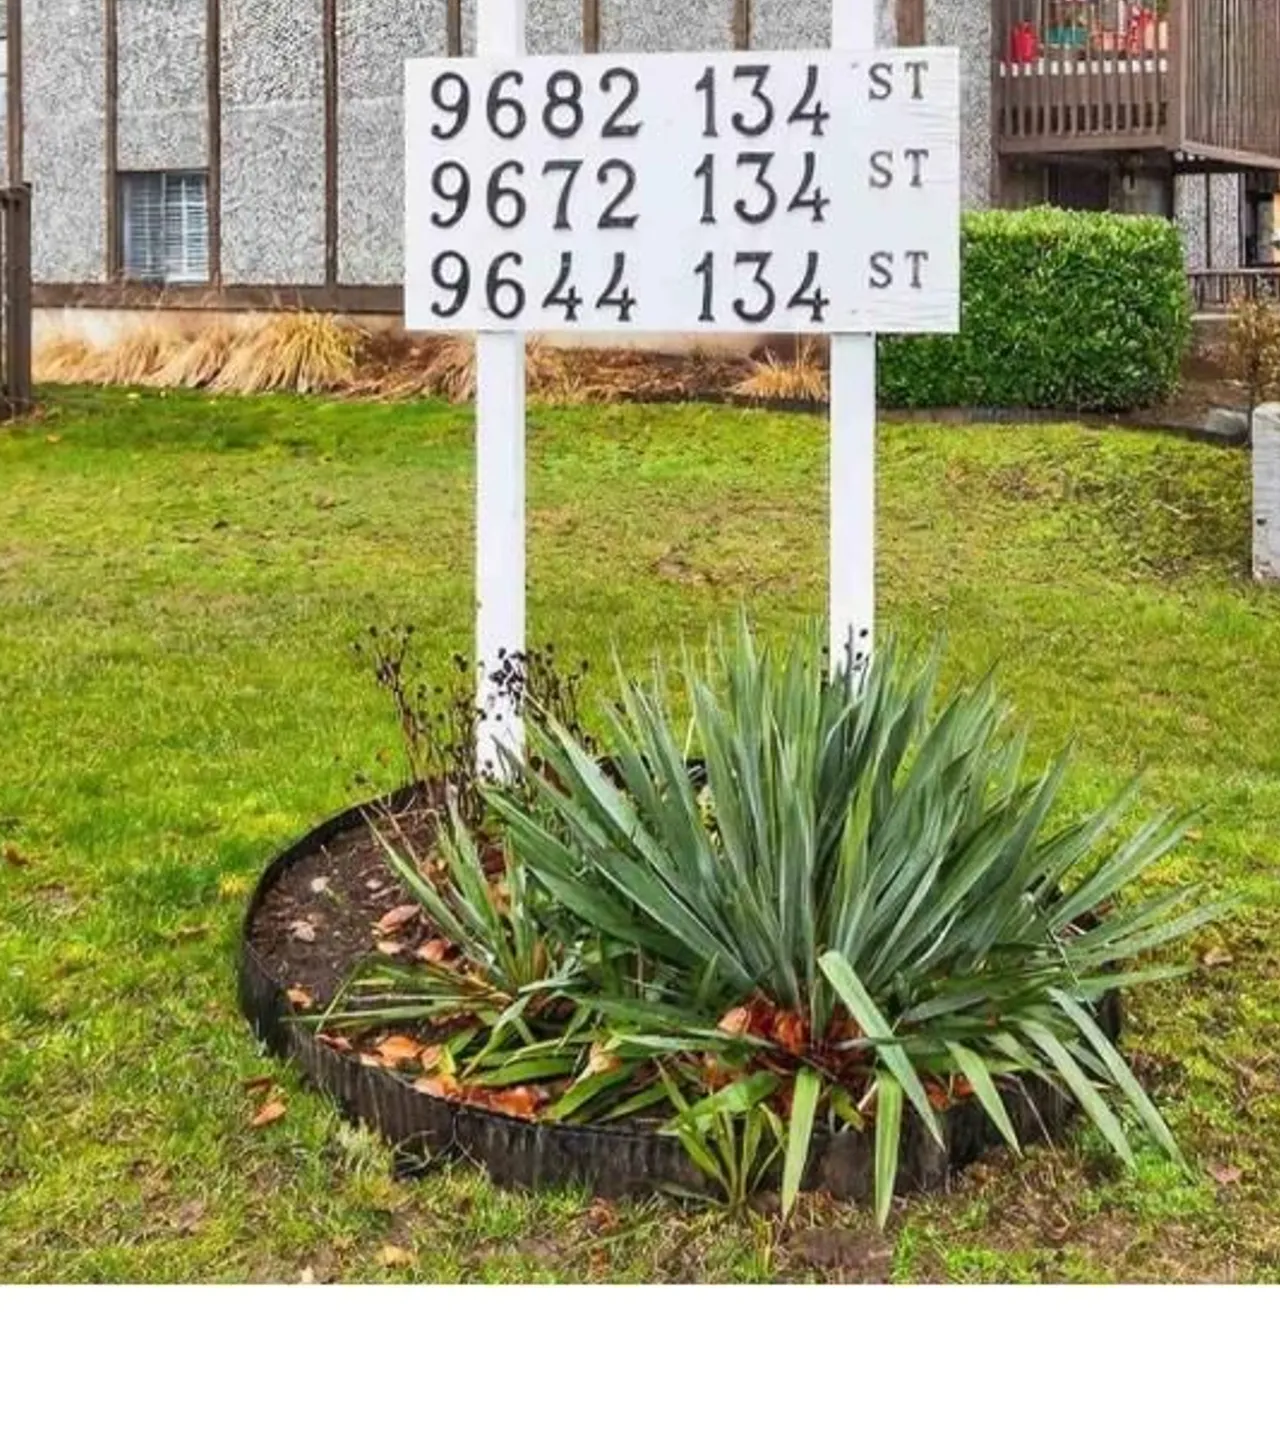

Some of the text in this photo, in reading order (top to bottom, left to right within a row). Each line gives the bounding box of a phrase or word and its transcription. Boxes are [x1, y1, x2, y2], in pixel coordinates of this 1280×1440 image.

[431, 61, 929, 140] 9682 134 ST
[431, 148, 929, 230] 9672 134 ST
[431, 249, 929, 323] 9644 134 ST
